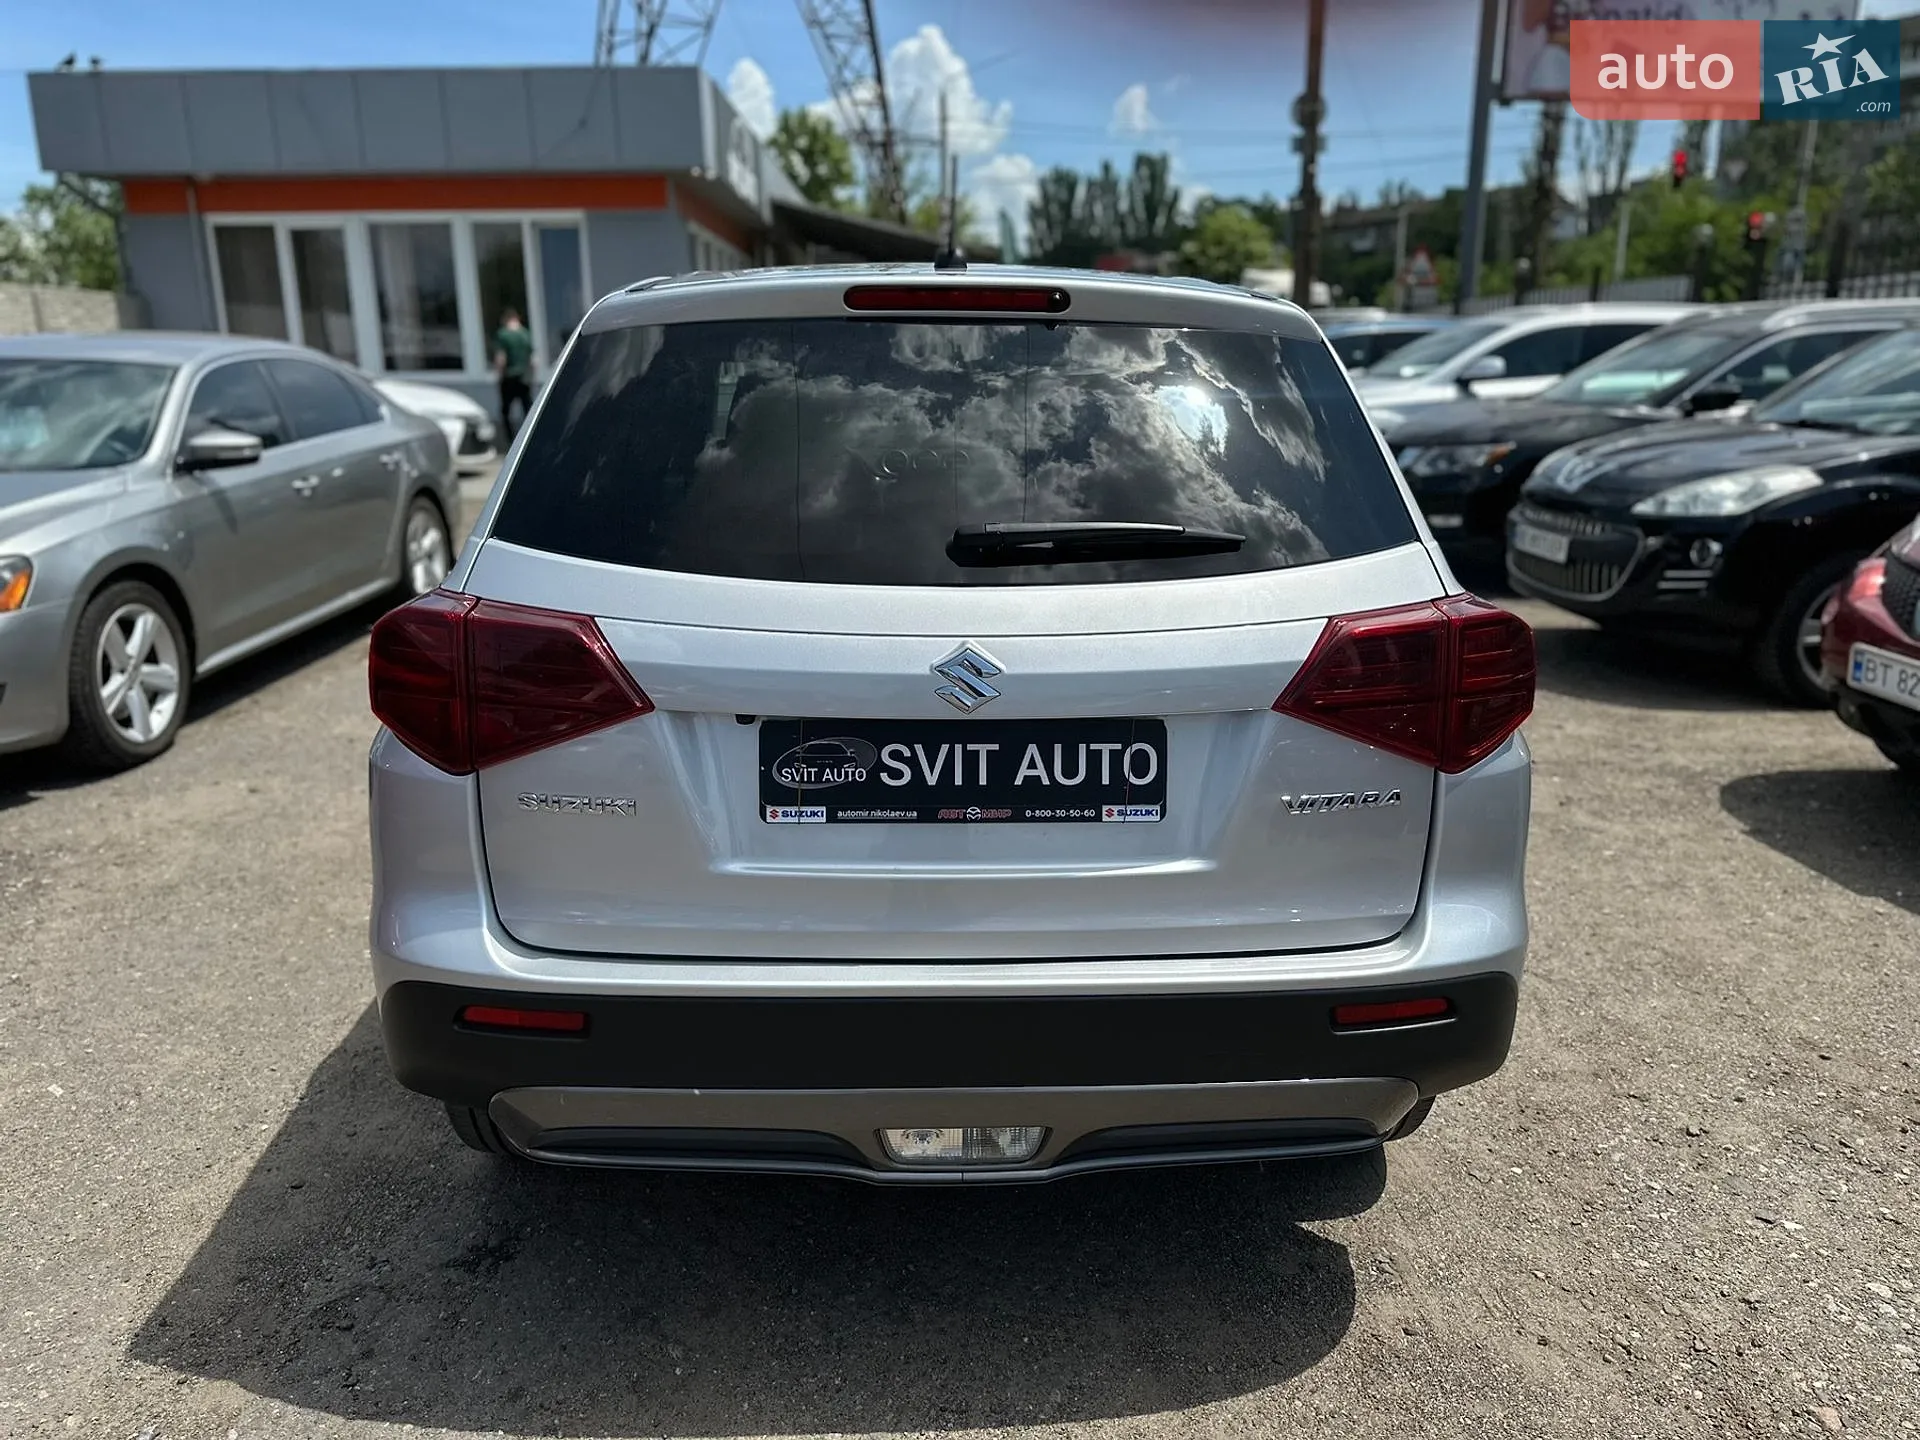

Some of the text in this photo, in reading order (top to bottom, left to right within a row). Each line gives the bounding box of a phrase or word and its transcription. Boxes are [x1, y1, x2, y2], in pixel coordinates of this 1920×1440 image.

[1865, 658, 1893, 688] BT
[879, 743, 1158, 786] SVIT AUTO
[781, 767, 867, 782] SVIT AUTO
[518, 791, 637, 816] SUZUKI
[1280, 788, 1401, 815] VITARA
[781, 809, 825, 818] SUZUKI
[837, 809, 917, 819] automir.nikolaev.ua
[1025, 808, 1096, 818] 0-800-30-50-60
[1116, 808, 1159, 818] SUZUKI
